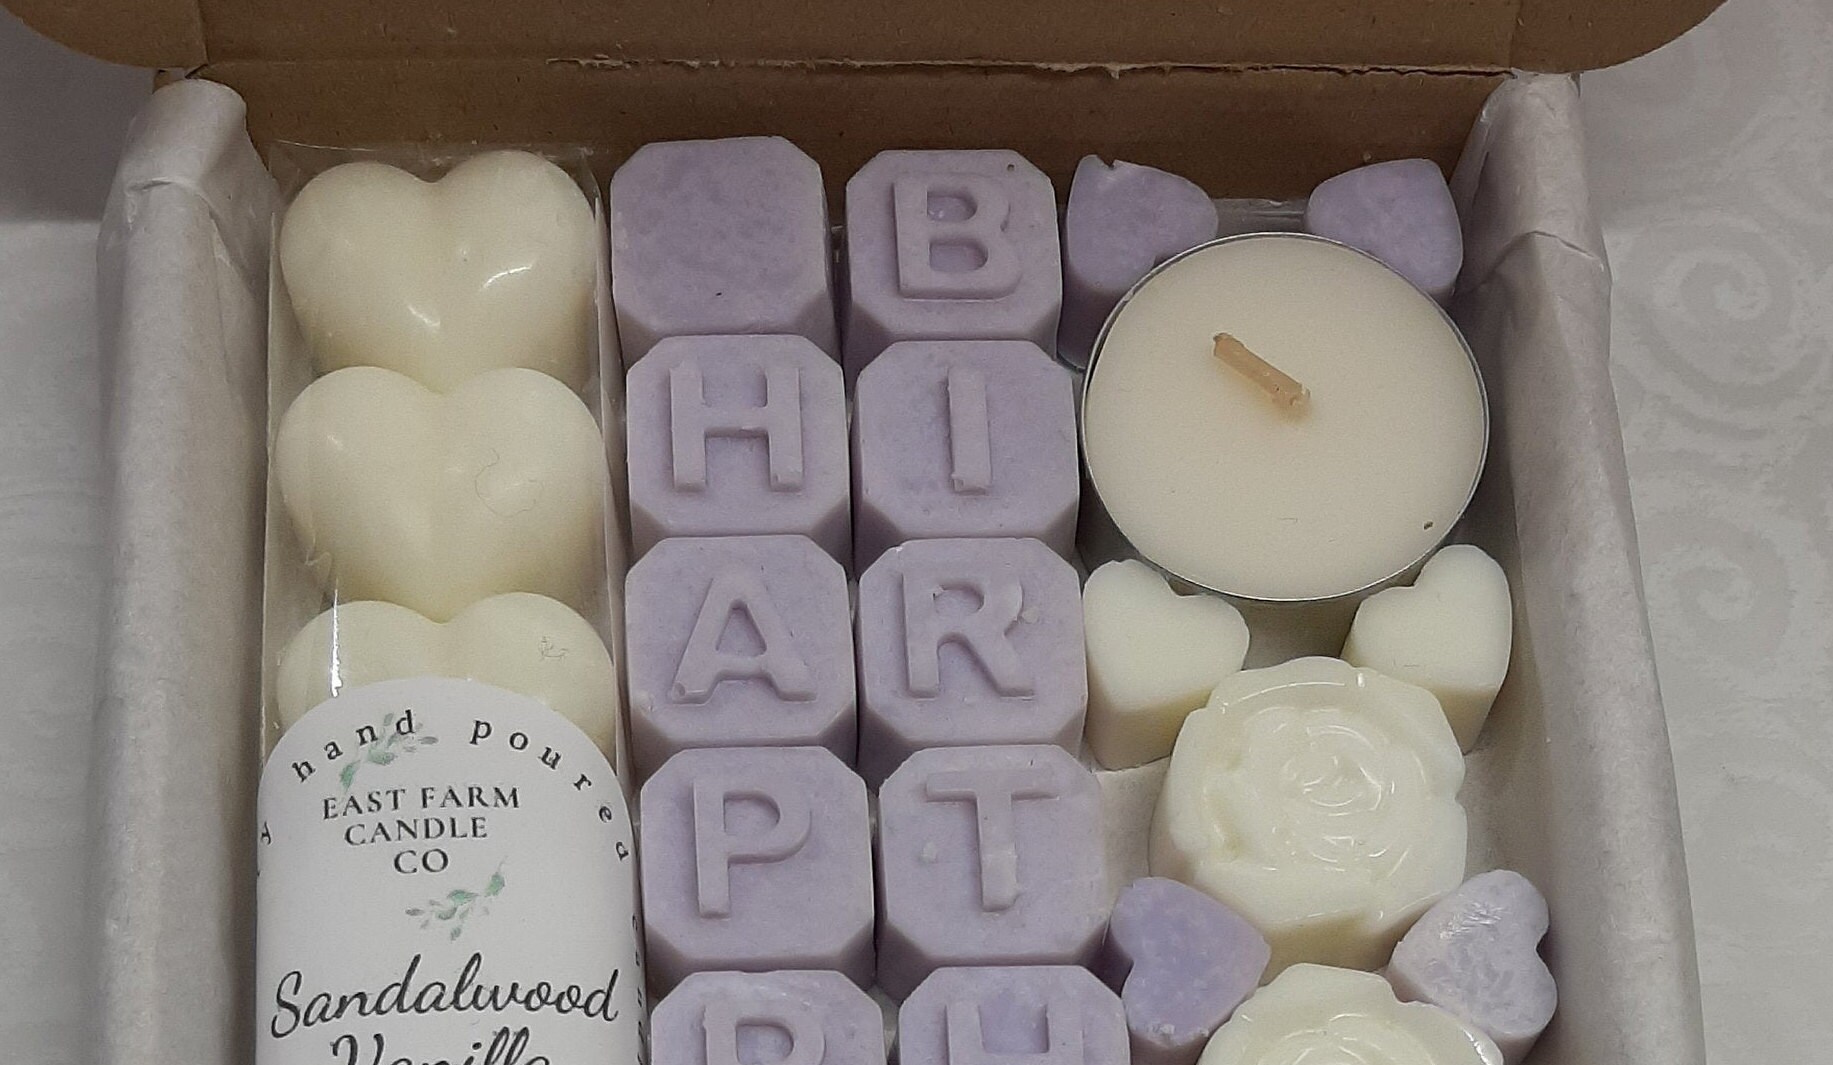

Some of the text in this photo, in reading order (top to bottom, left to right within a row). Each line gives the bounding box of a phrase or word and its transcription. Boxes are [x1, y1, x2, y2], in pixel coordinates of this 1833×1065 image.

[292, 709, 417, 783] hand
[322, 786, 521, 821] EAST FARM
[343, 816, 489, 847] CANDLE
[392, 848, 450, 875] CO
[270, 952, 620, 1039] Sandalwood
